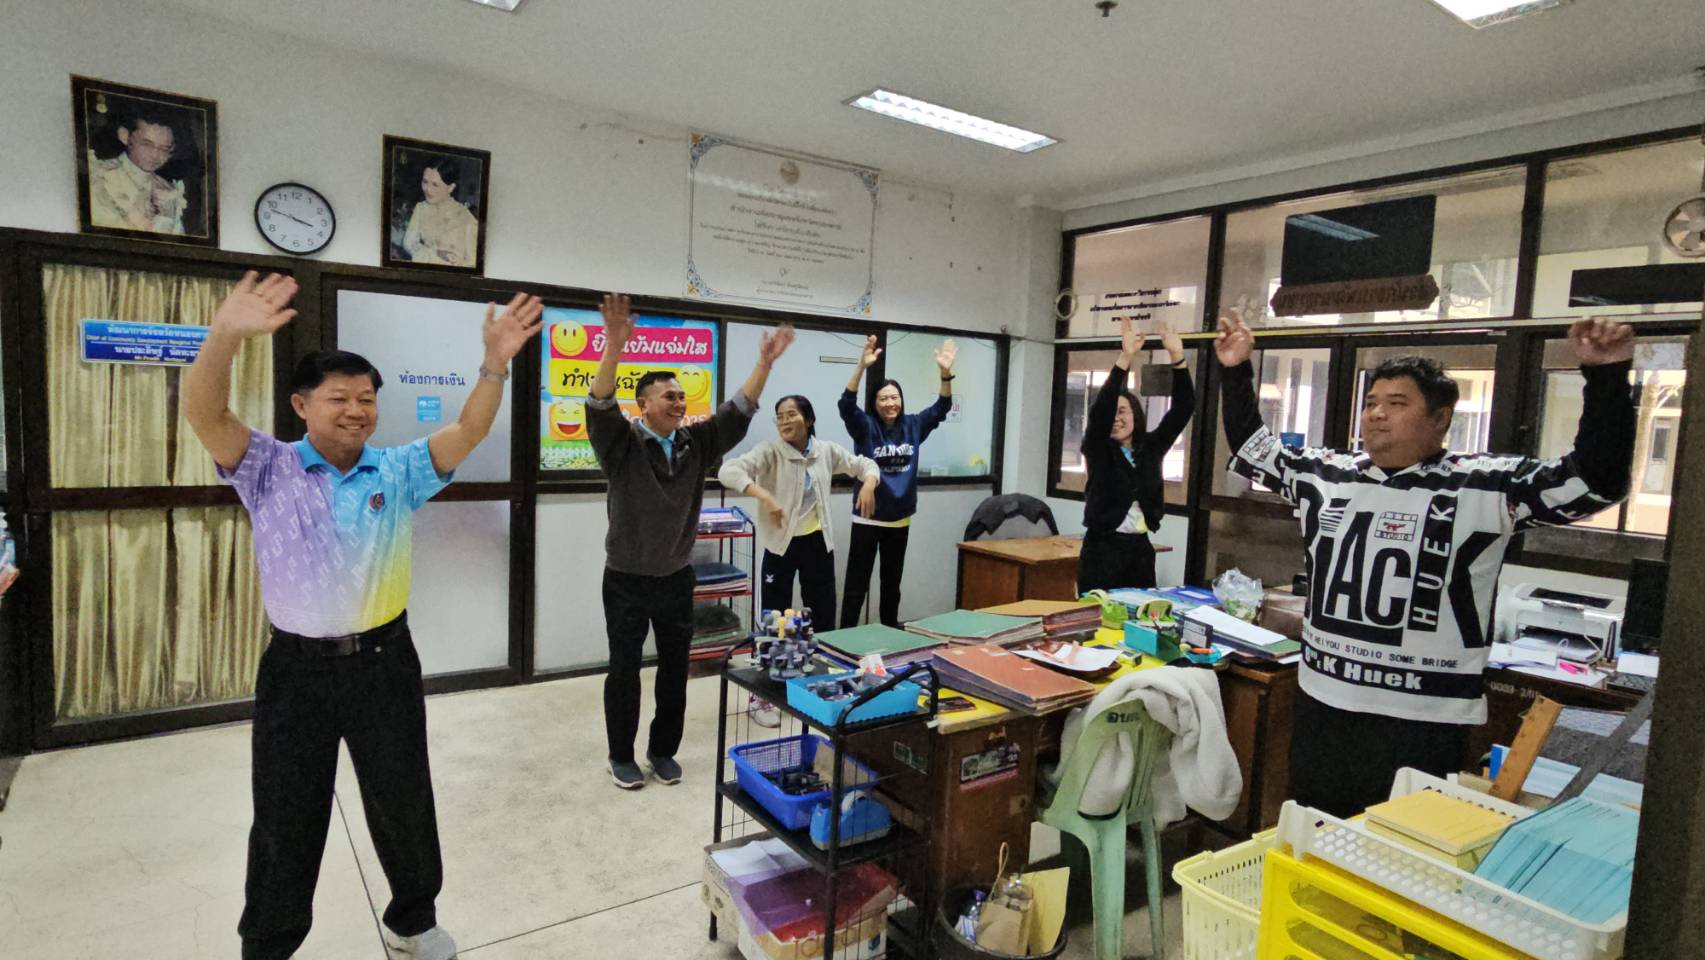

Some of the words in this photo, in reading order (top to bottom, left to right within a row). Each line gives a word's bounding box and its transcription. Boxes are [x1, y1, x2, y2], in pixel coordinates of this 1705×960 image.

[400, 370, 466, 386] ห้องการเงิน
[1412, 502, 1455, 627] HUEK
[1345, 645, 1382, 659] STUDIO
[1389, 653, 1416, 664] SOME
[1422, 657, 1458, 668] BRIDGE
[1344, 662, 1422, 689] Huek
